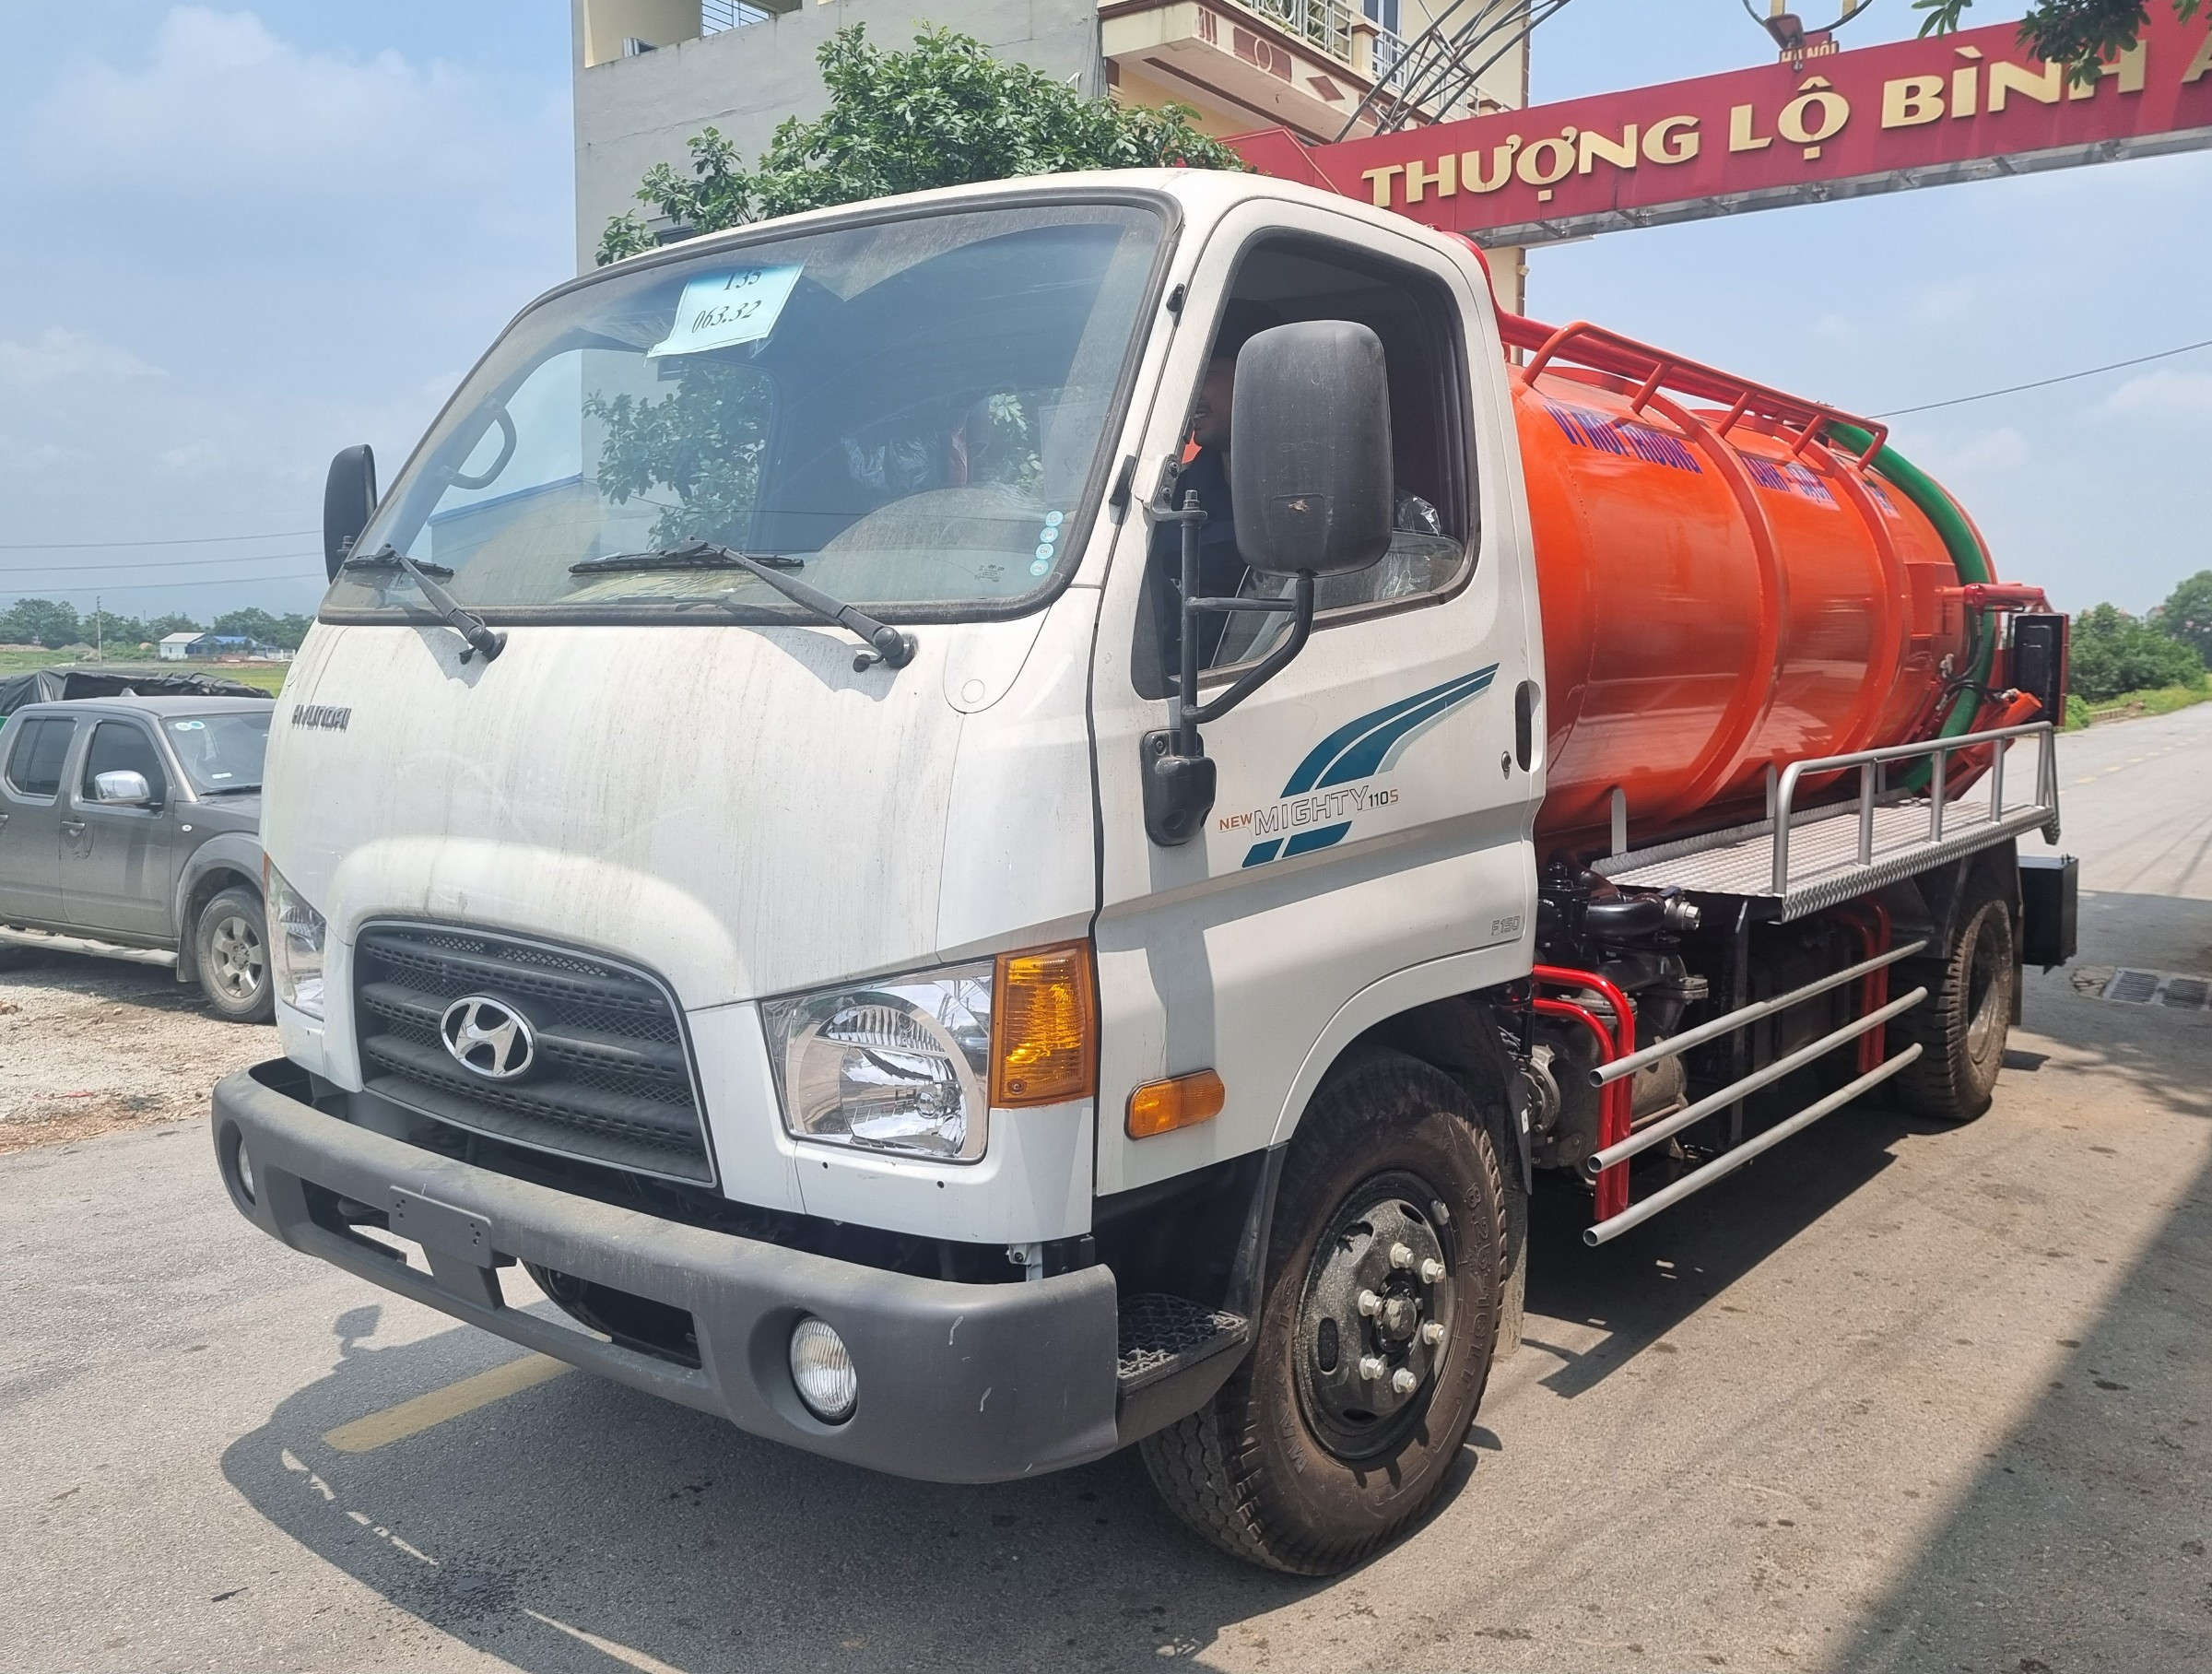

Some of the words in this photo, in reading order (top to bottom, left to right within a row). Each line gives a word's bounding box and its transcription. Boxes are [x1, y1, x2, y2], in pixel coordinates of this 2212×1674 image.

[1361, 115, 1700, 208] THƯỢNG
[1729, 76, 1851, 160] LỘ
[1881, 41, 2147, 128] BÌNH
[691, 300, 762, 333] 063.32
[1219, 812, 1253, 831] NEW
[1253, 785, 1370, 836] MIGHTY
[1368, 789, 1399, 808] 110S
[1491, 915, 1520, 935] F150
[1275, 1275, 1310, 1475] MAXXIS
